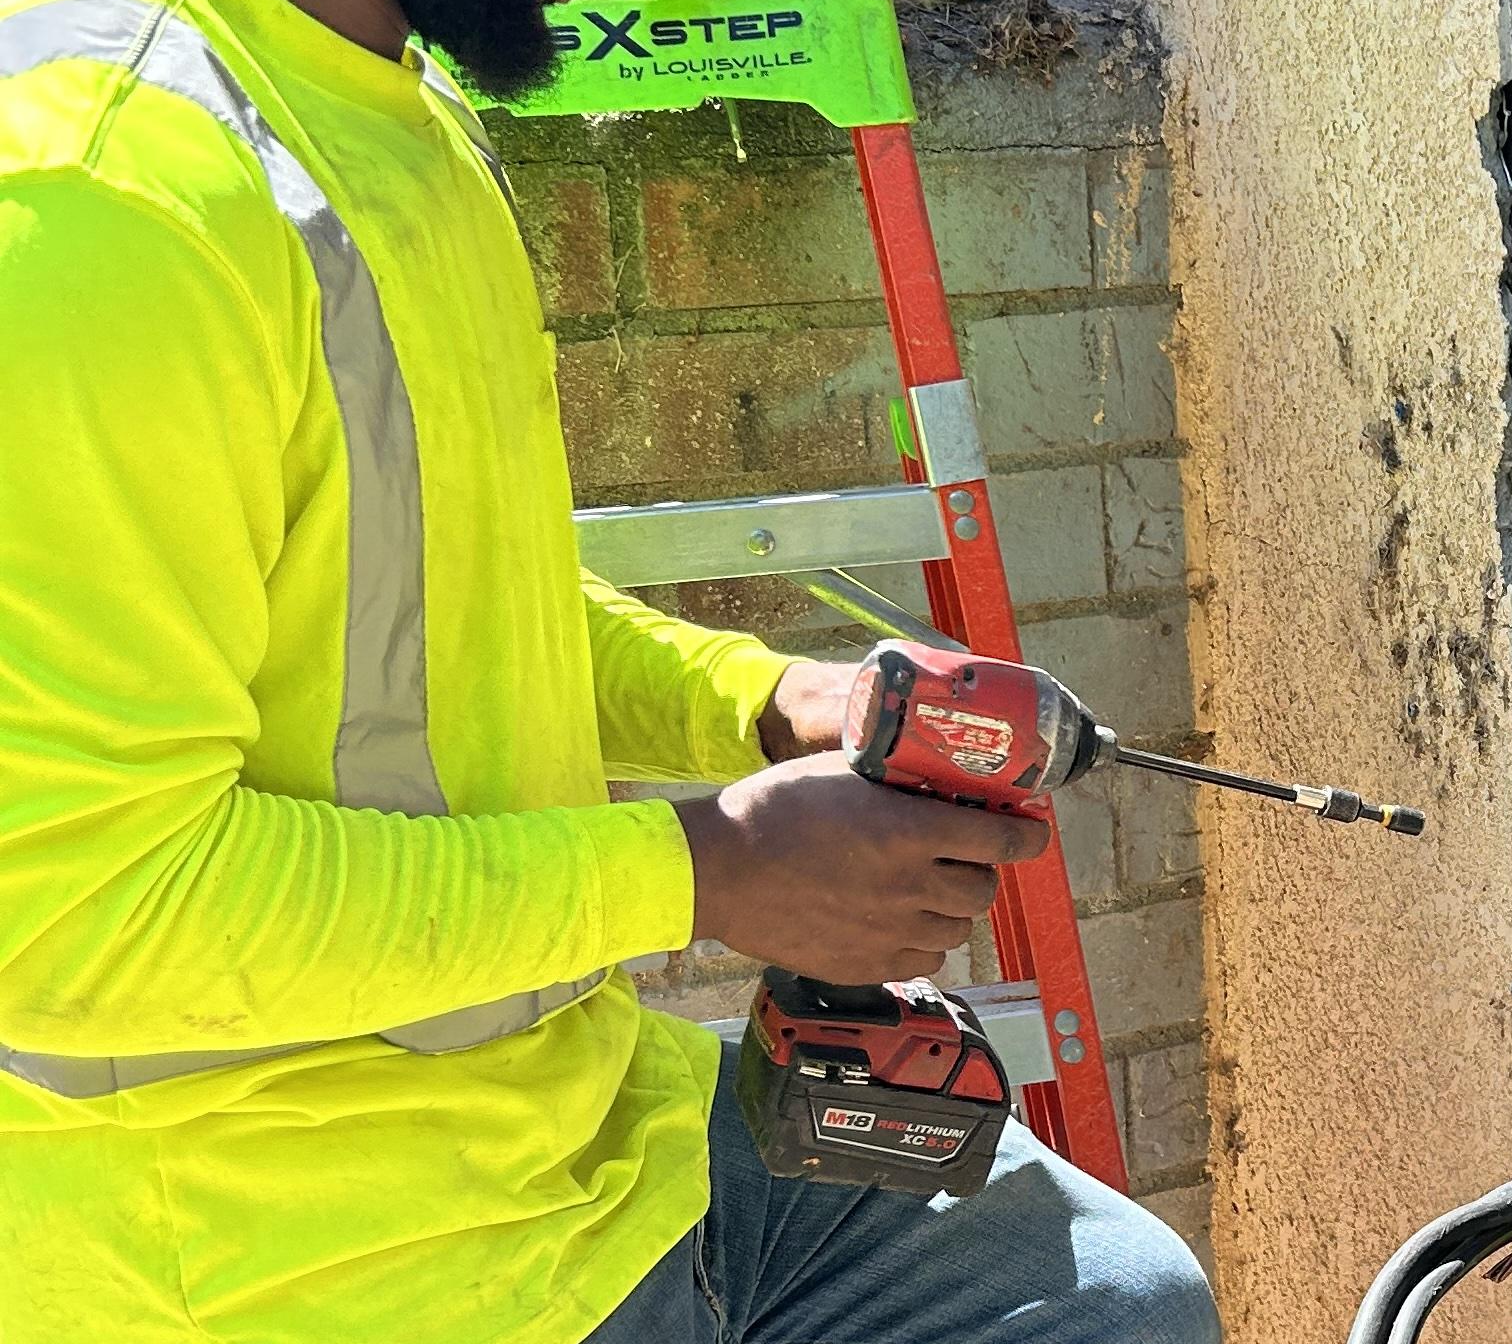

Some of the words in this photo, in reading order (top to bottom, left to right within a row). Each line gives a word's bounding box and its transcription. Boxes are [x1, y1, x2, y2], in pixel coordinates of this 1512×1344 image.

[619, 63, 644, 81] by
[826, 1111, 871, 1128] M18
[877, 1120, 966, 1138] REDLITHIUM
[899, 1134, 957, 1150] XC5.0
